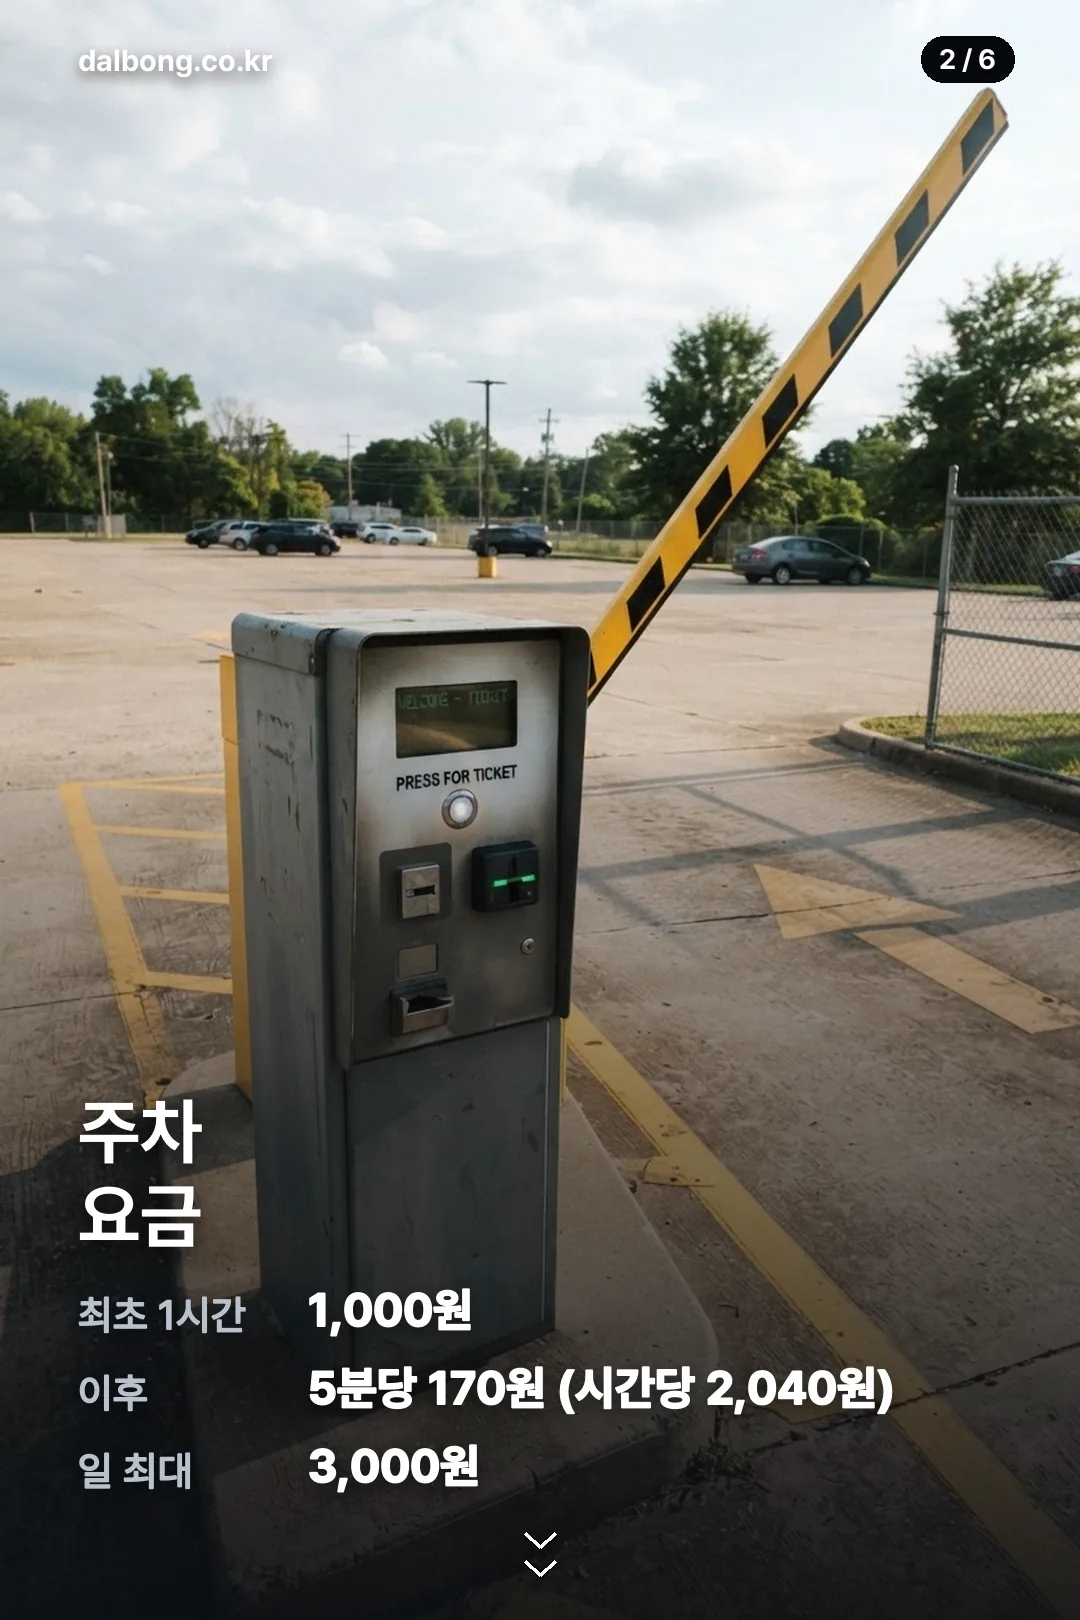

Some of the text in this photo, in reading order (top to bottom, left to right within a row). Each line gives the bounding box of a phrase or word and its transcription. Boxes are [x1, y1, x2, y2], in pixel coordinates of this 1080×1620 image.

[396, 764, 518, 792] PRESS FOR TICKET
